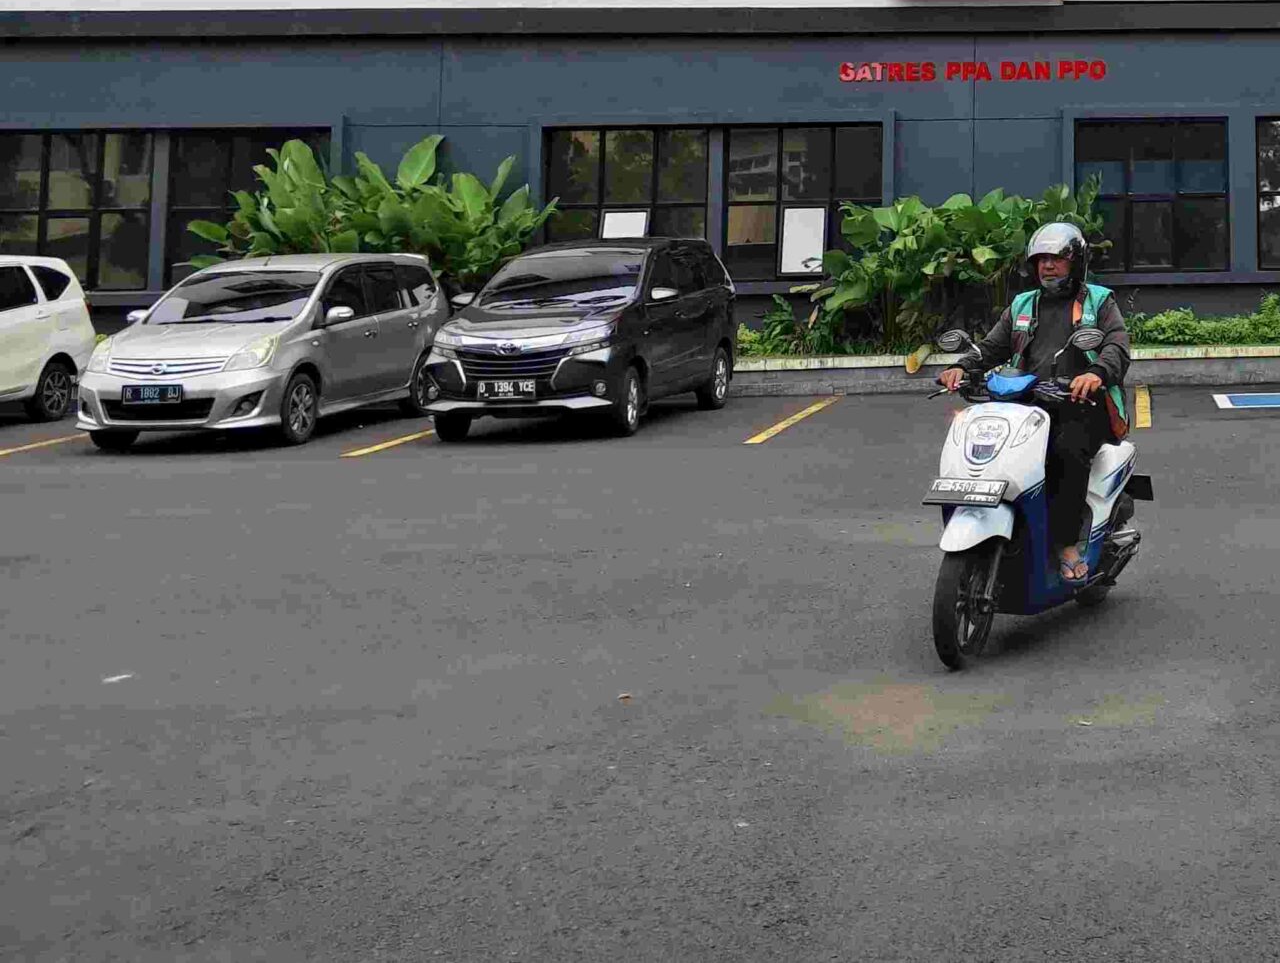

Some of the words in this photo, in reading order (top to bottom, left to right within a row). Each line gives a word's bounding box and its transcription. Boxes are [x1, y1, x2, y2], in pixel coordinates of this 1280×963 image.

[839, 61, 937, 83] SATRES
[946, 61, 993, 81] PPA
[1000, 60, 1050, 81] DAN
[1056, 59, 1107, 81] PPO
[126, 388, 132, 398] R
[494, 381, 514, 393] 1394
